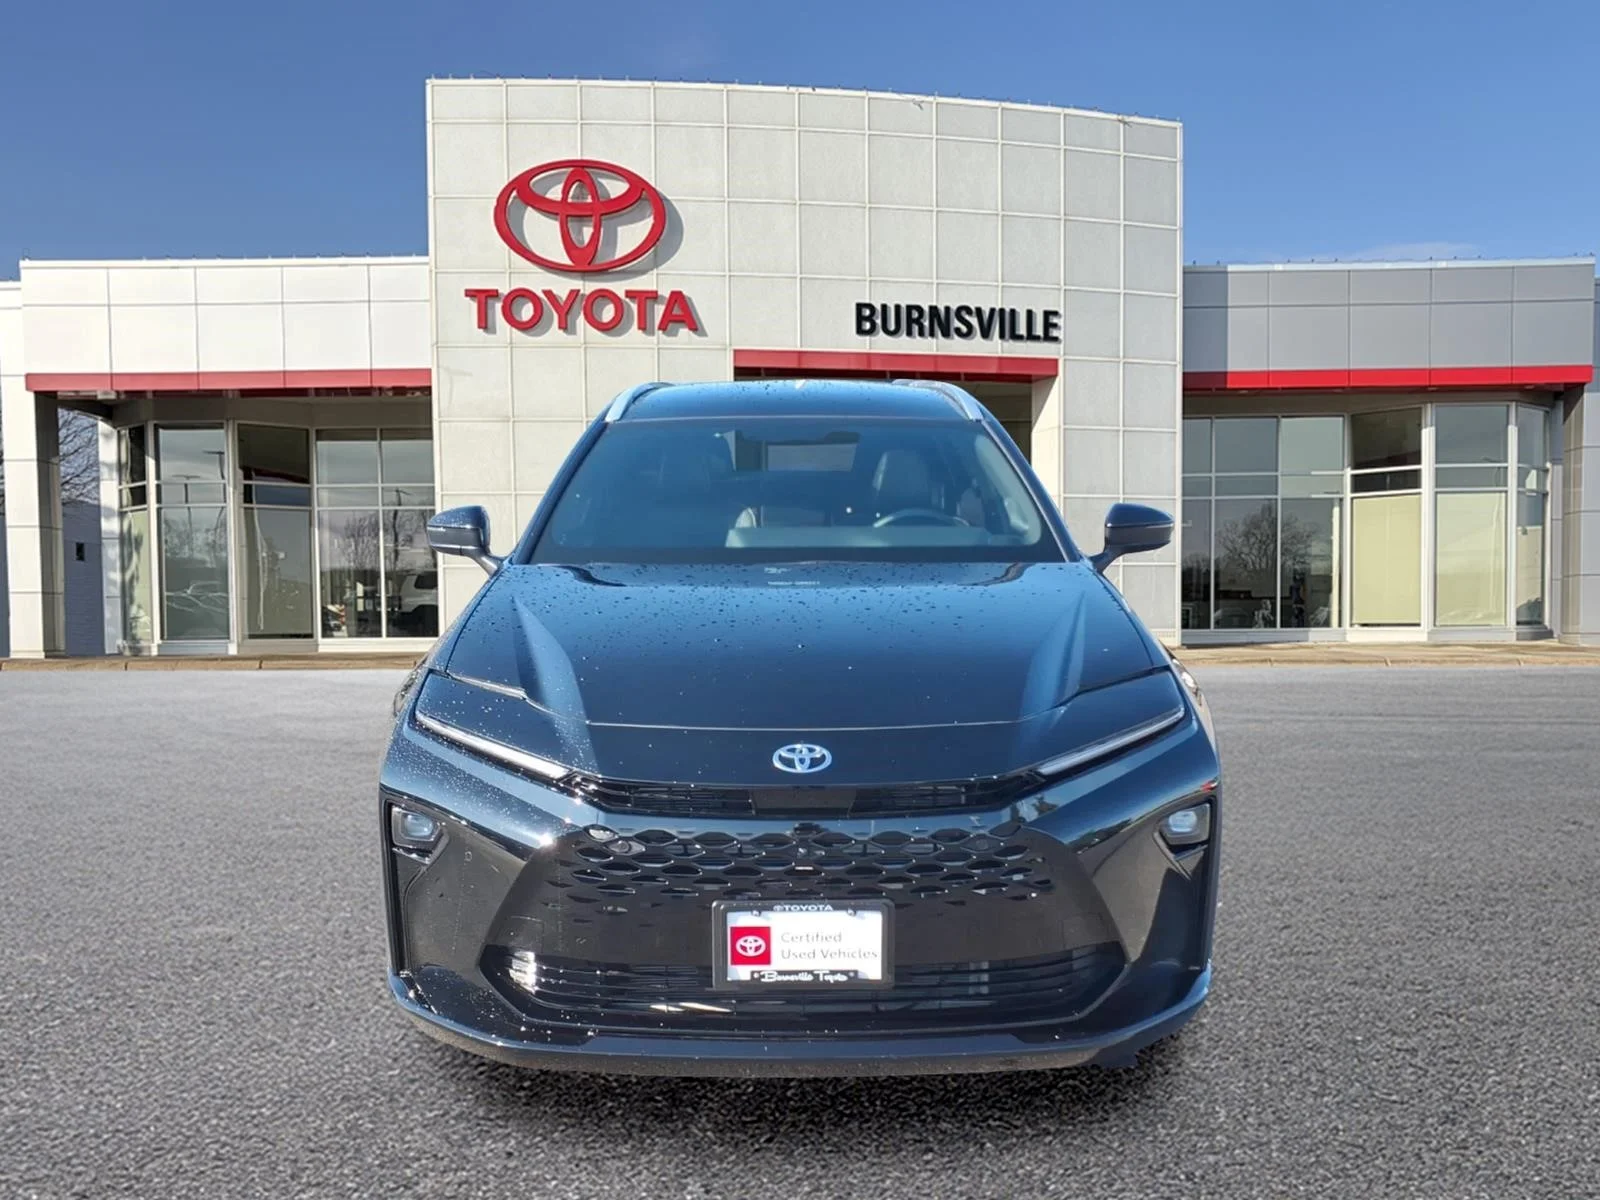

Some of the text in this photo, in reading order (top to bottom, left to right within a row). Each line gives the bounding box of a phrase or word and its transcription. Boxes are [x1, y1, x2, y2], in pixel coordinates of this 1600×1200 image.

[464, 287, 698, 331] TOYOTA
[855, 302, 1060, 342] BURNSVILLE
[783, 904, 834, 912] TOYOTA
[781, 932, 842, 943] Certified
[781, 949, 878, 960] Used Vehicles
